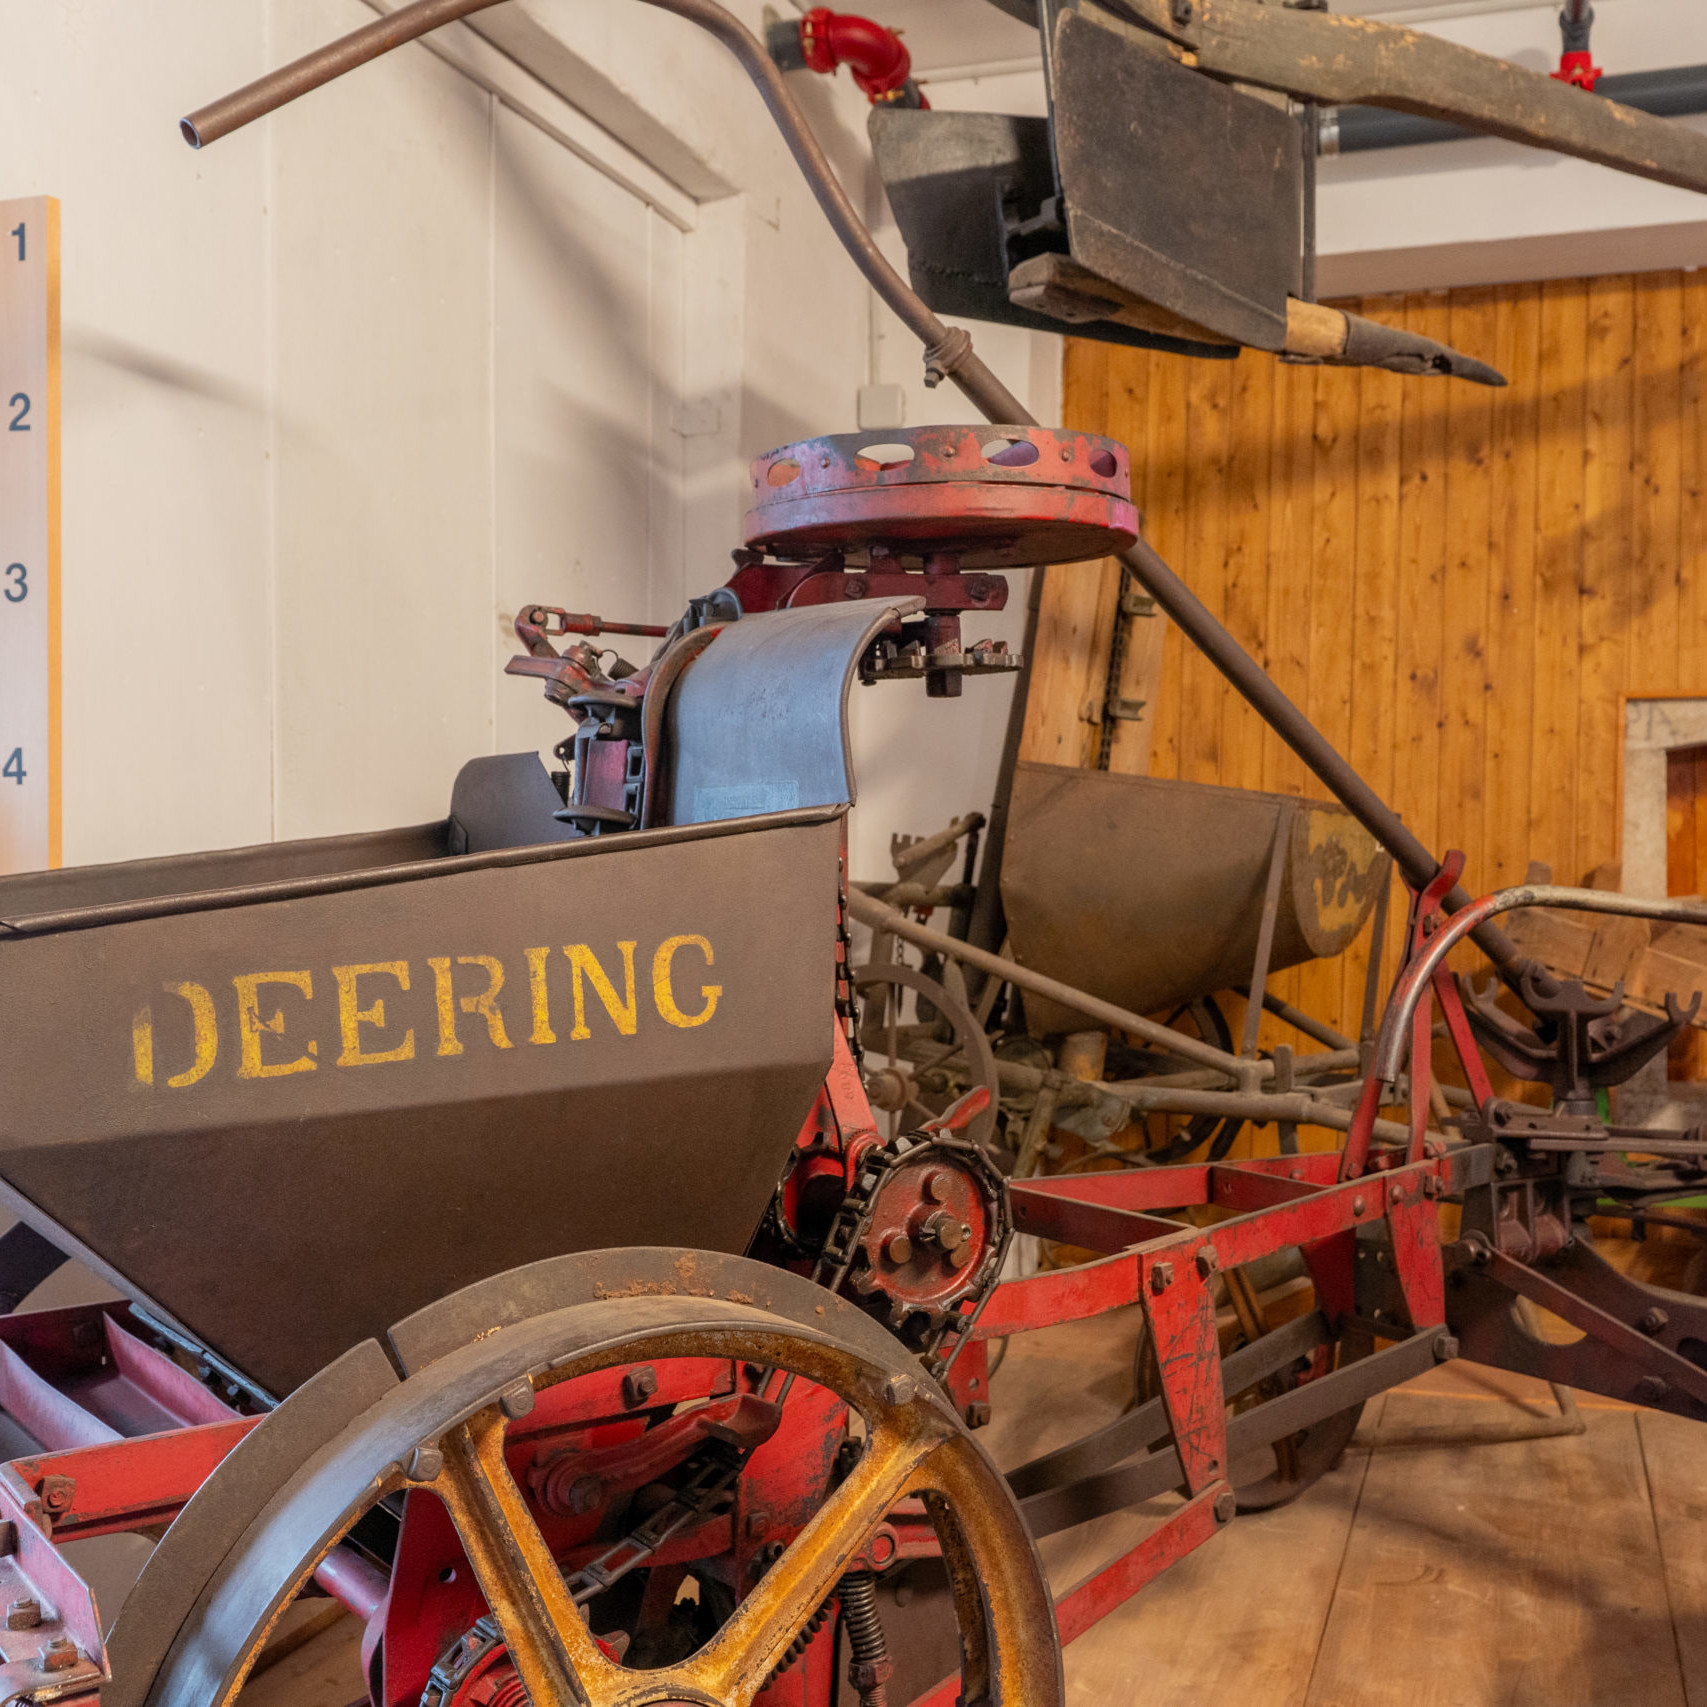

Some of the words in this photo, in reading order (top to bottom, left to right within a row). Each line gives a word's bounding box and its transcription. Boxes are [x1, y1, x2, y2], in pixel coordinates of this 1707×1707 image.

[11, 221, 27, 261] 1
[8, 391, 31, 431] 2
[4, 562, 28, 603] 3
[2, 747, 27, 785] 4
[131, 934, 722, 1088] DEERING
